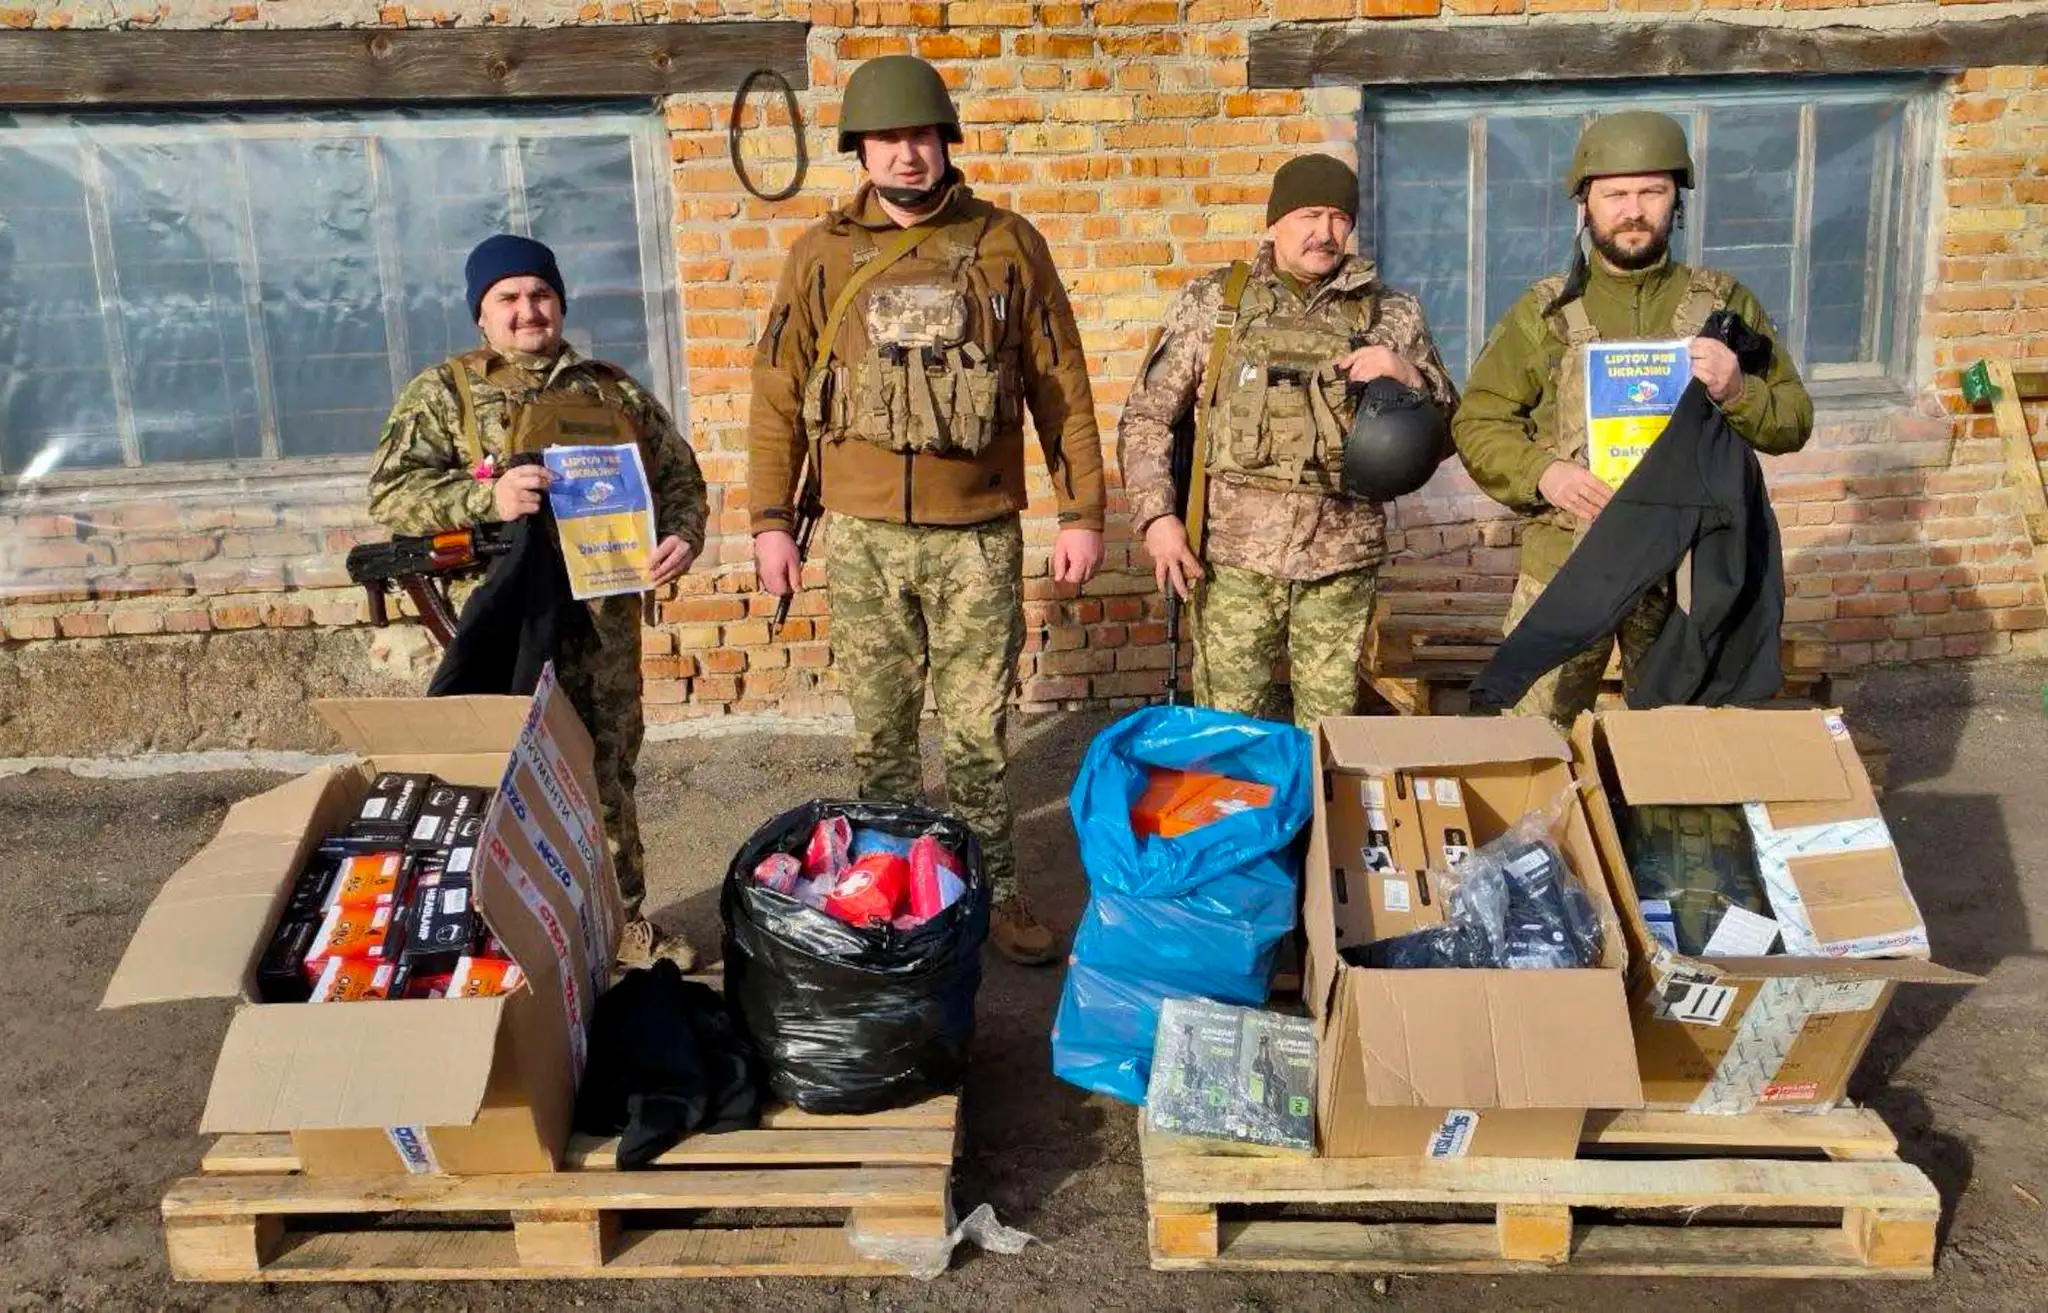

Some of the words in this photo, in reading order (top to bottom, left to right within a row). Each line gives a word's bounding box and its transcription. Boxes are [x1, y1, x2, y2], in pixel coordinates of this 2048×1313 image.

[1604, 353, 1649, 365] LIPTOV
[1652, 352, 1677, 363] PRE
[520, 730, 571, 822] ОКУМЕНТИ
[418, 887, 437, 941] HEADLAMP
